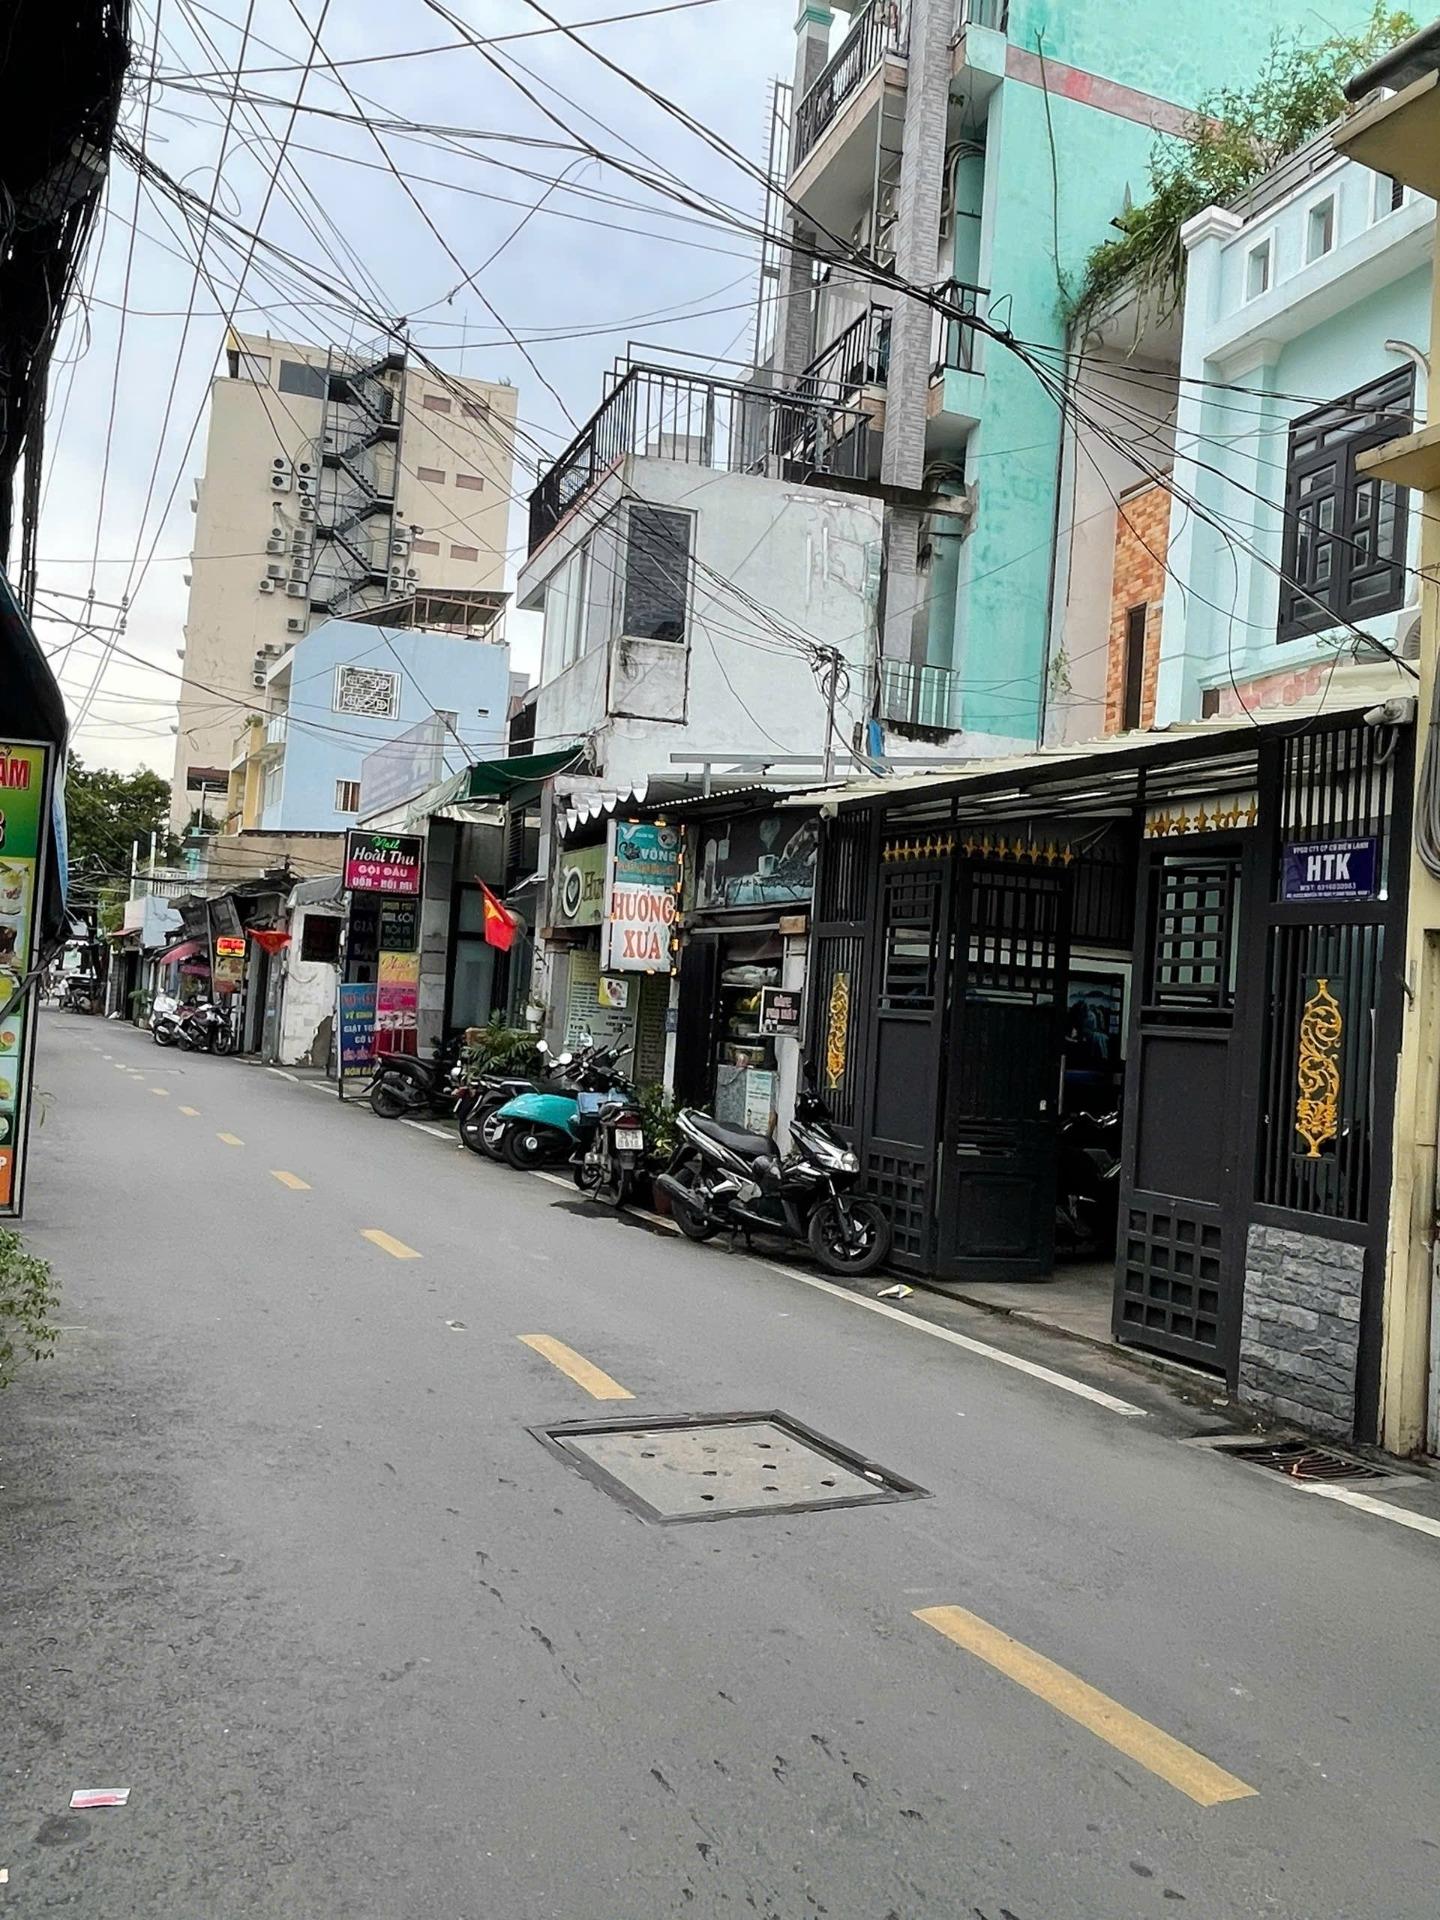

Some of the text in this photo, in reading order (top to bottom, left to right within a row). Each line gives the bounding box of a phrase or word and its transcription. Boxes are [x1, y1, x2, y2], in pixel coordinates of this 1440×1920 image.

[353, 847, 414, 866] Hoài Thu
[1306, 853, 1351, 882] HTK
